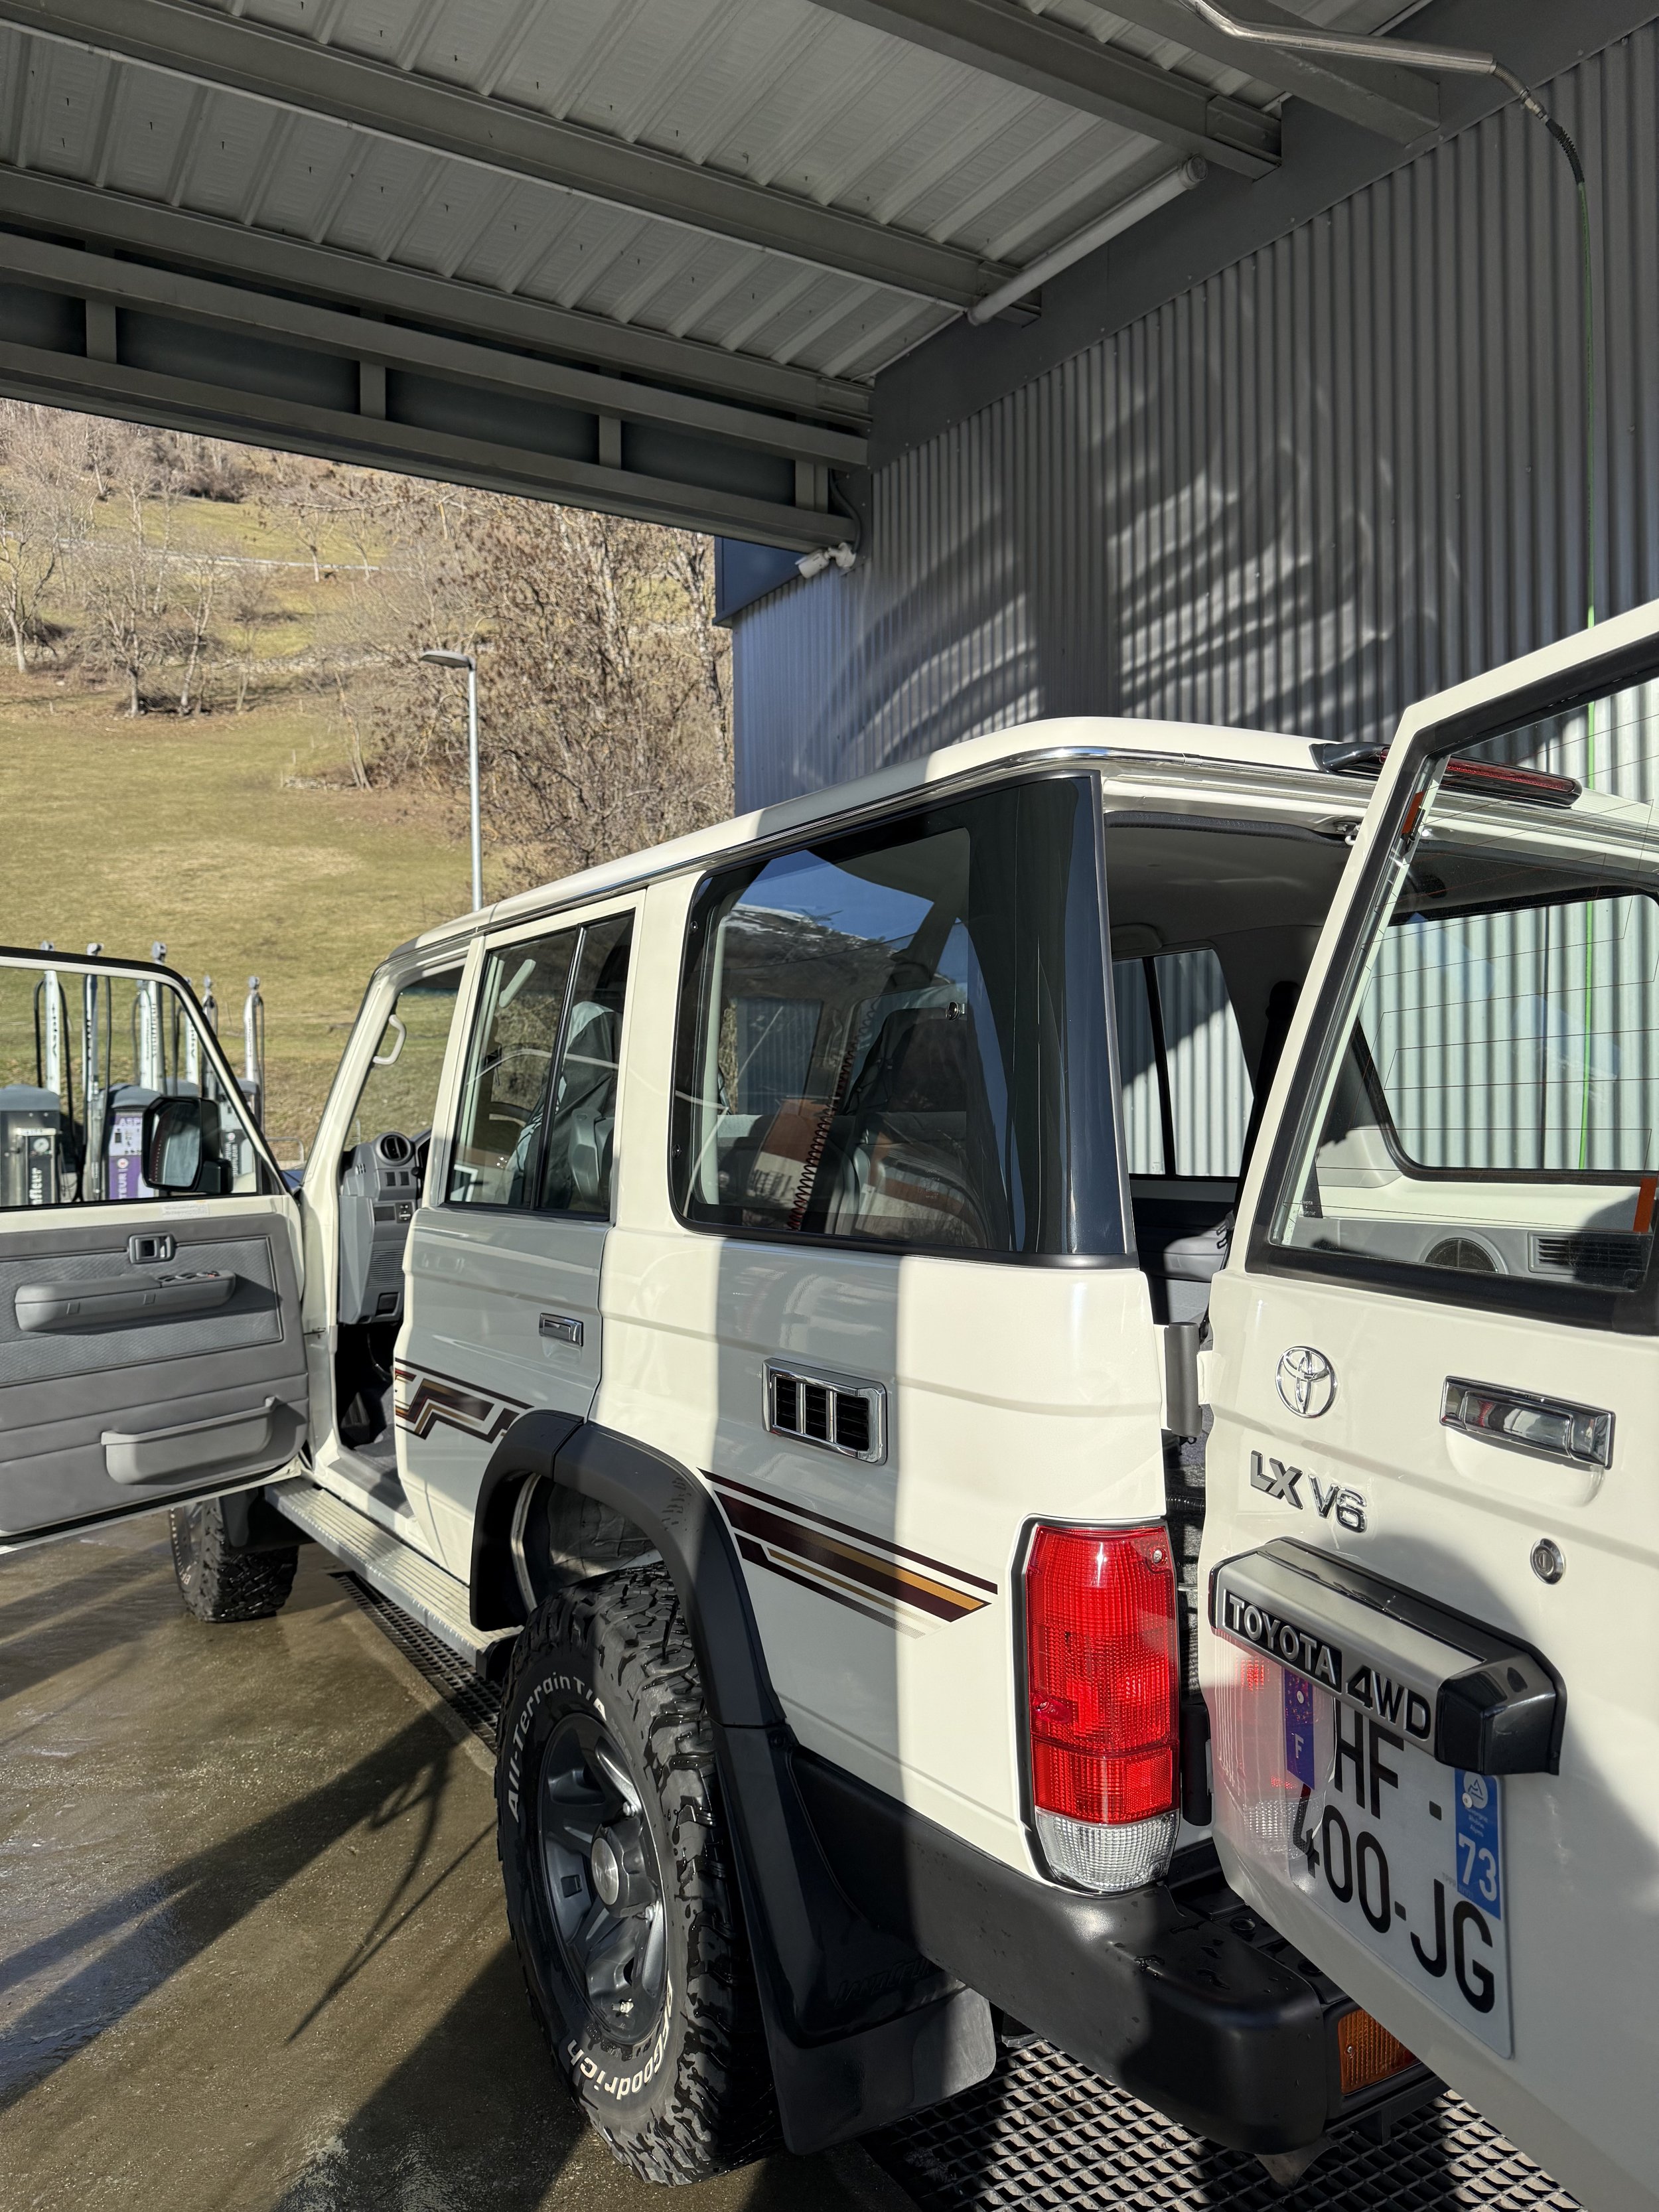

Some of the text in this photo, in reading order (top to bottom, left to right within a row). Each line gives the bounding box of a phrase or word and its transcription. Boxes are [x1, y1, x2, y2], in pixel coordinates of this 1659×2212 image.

[1250, 1450, 1368, 1533] LX V6
[1228, 1592, 1431, 1741] TOYOTA 4WD
[508, 1671, 571, 1824] All-Terrain
[1291, 1733, 1303, 1760] F
[1458, 1832, 1498, 1901] 73
[567, 1970, 673, 2101] BFGoodrich
